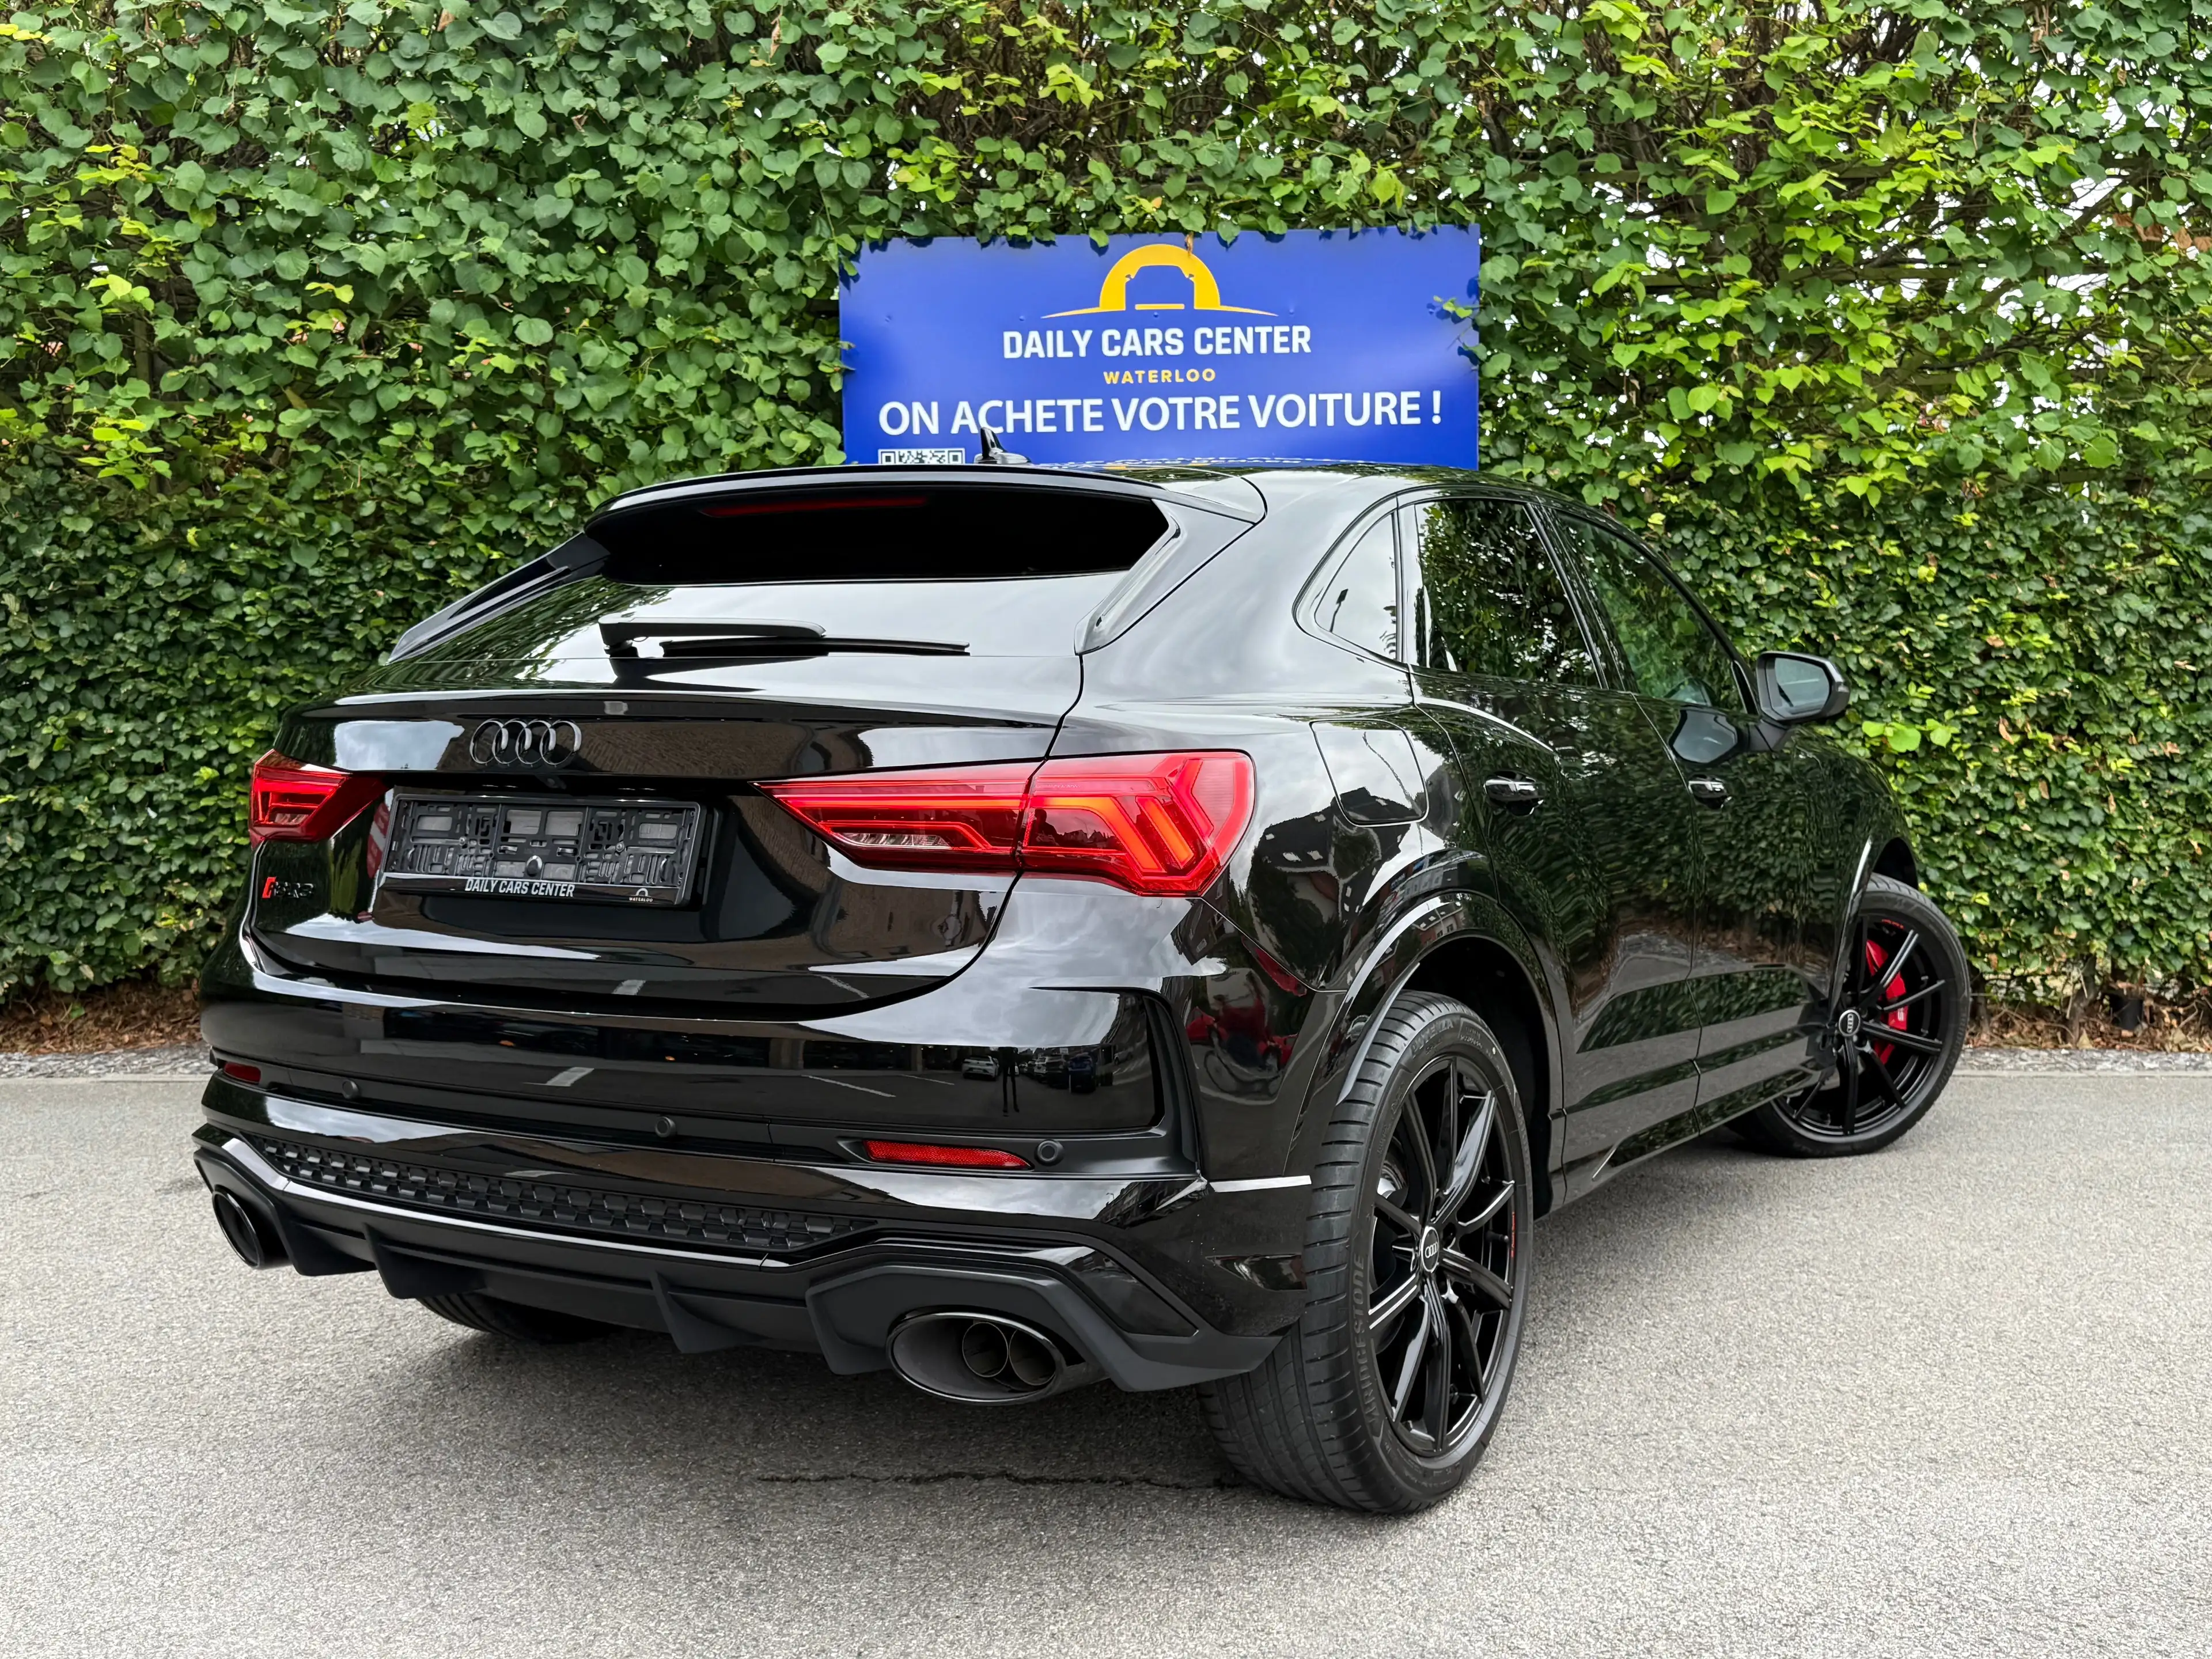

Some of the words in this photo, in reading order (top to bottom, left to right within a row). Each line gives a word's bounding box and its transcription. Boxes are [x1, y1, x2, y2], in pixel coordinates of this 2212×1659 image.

[1003, 330, 1093, 359] DAILY
[1101, 328, 1184, 357] CARS
[1194, 325, 1312, 355] CENTER
[1104, 369, 1217, 384] WATERLOO
[879, 401, 939, 435] ON
[950, 398, 1104, 434] ACHETE
[1111, 395, 1240, 431] VOTRE
[1247, 391, 1421, 428] VOITURE
[1432, 390, 1441, 424] !
[465, 878, 498, 892] DAILY
[499, 880, 529, 895] CARS
[531, 882, 575, 897] CENTER
